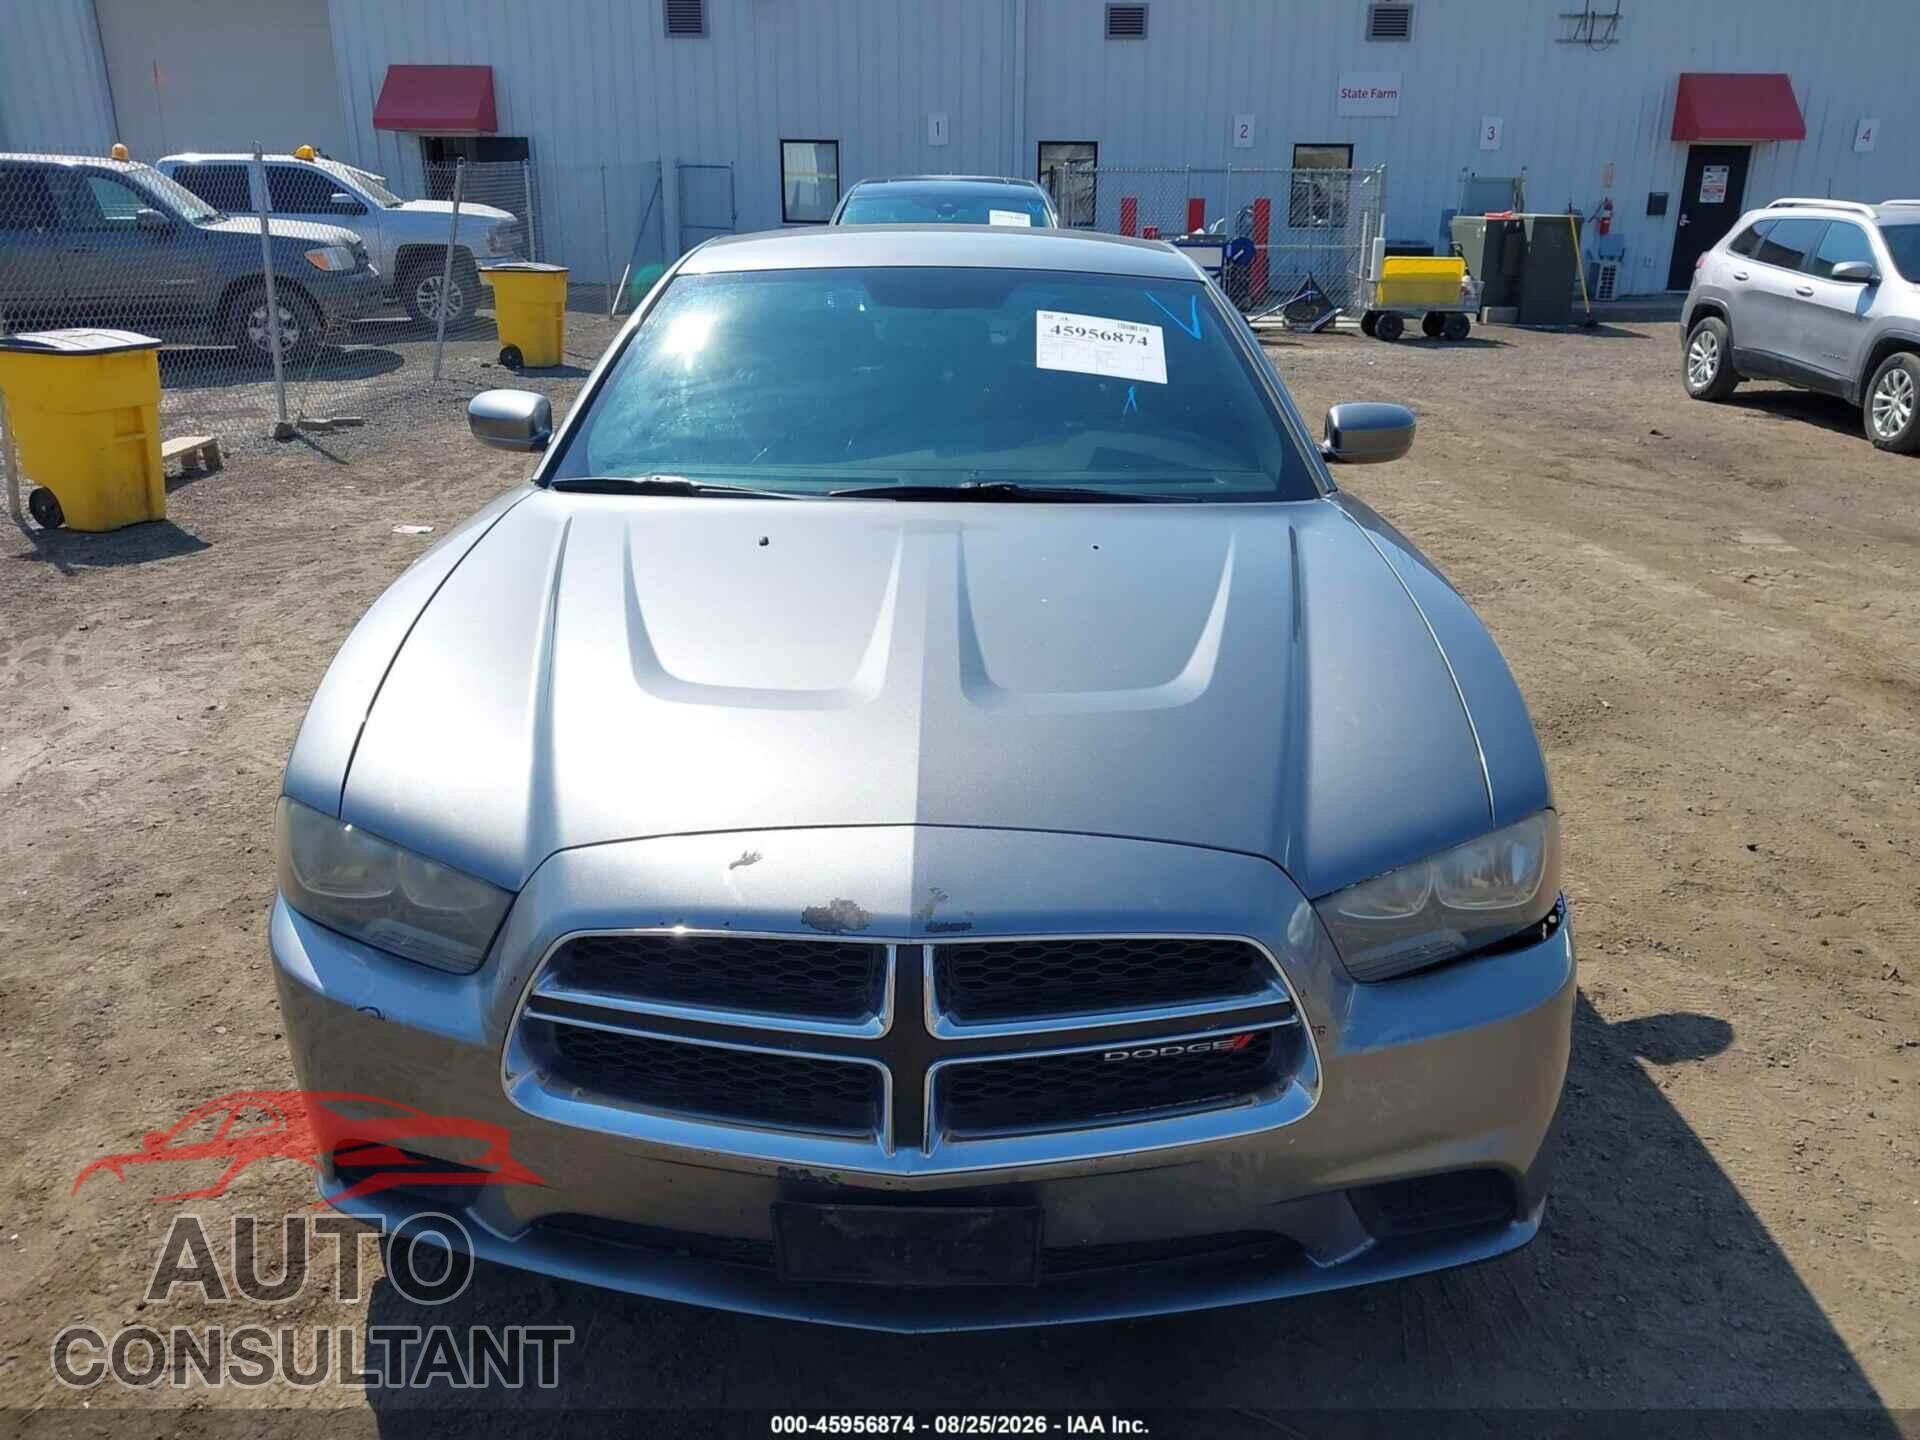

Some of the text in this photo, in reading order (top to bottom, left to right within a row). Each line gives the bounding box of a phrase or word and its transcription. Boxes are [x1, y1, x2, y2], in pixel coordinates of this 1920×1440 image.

[1341, 88, 1398, 99] State Farm
[1239, 124, 1249, 139] 2
[1487, 126, 1496, 140] 3
[1861, 128, 1872, 143] 4
[1050, 324, 1149, 346] 45956874
[1103, 1039, 1234, 1062] DODGE
